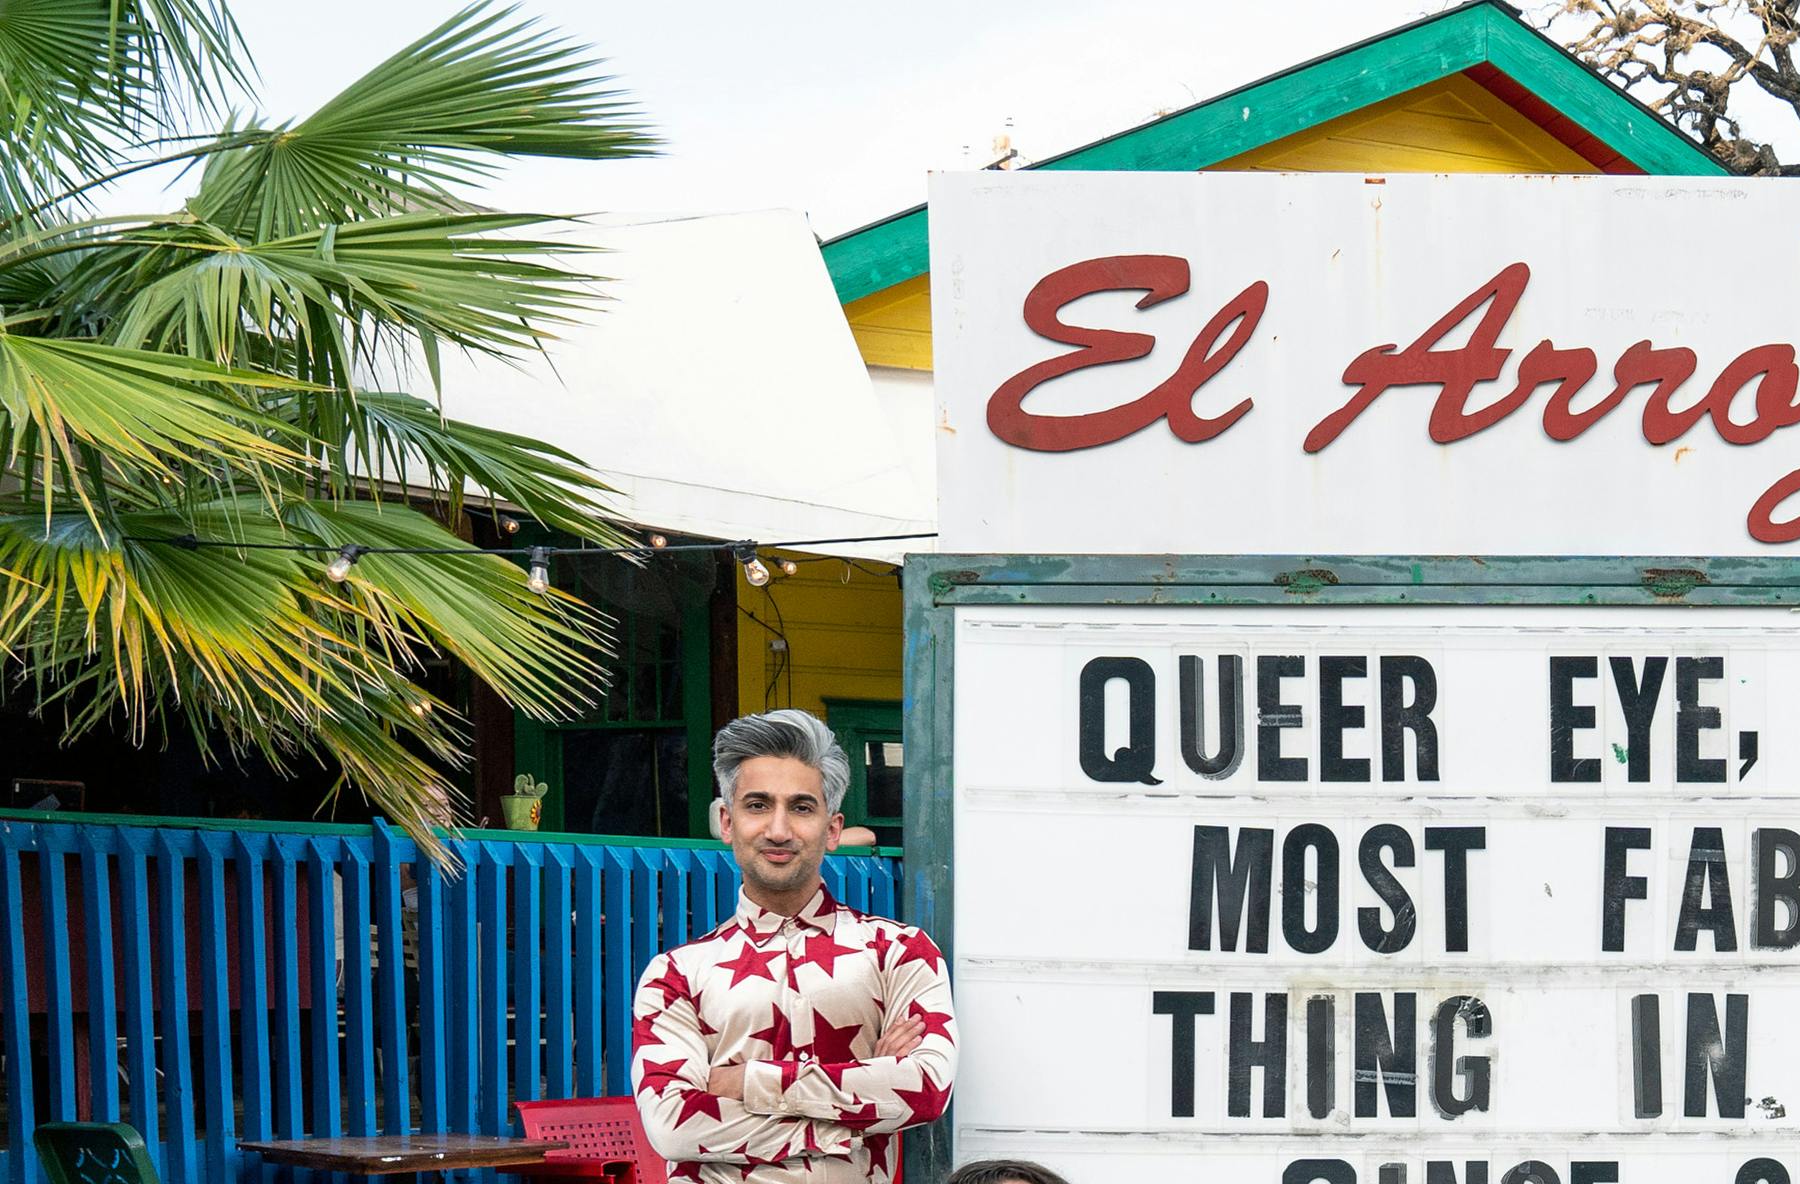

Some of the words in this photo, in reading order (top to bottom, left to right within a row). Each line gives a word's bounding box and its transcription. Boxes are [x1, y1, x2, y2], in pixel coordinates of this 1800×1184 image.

[987, 255, 1270, 452] El
[1080, 654, 1440, 786] QUEER
[1550, 656, 1760, 783] EYE,
[1188, 823, 1486, 955] MOST
[1152, 991, 1492, 1120] THING
[1632, 992, 1751, 1119] IN
